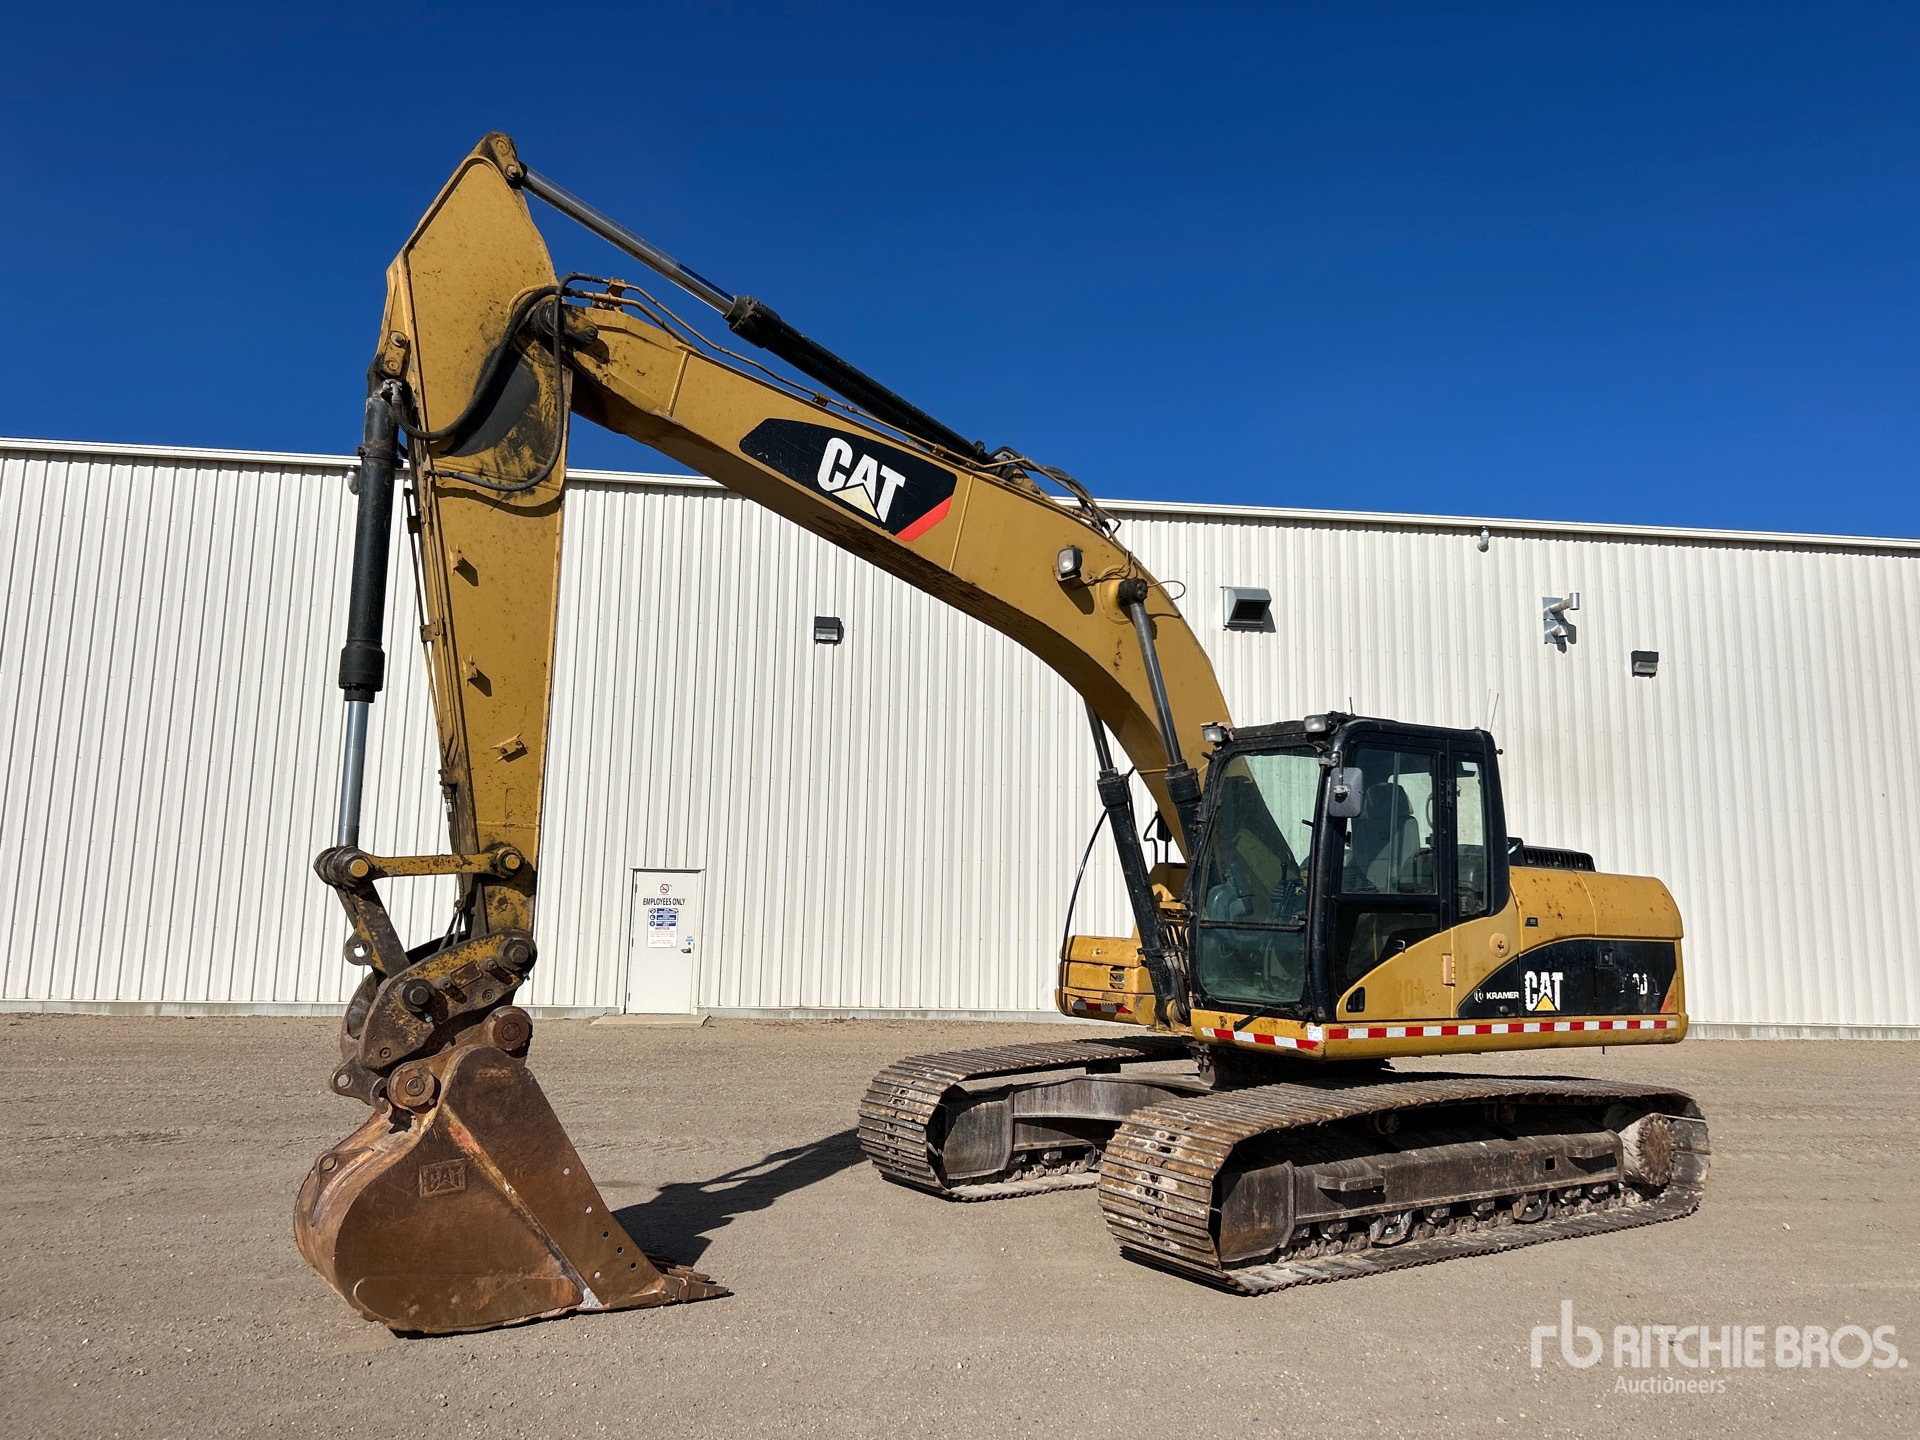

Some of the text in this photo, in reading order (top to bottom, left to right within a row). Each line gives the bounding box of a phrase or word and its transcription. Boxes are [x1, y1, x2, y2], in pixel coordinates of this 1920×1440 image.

[817, 437, 906, 523] CAT
[643, 898, 685, 906] EMPLOYEES ONLY
[1486, 991, 1519, 1000] KRAMER
[1524, 970, 1564, 1012] CAT
